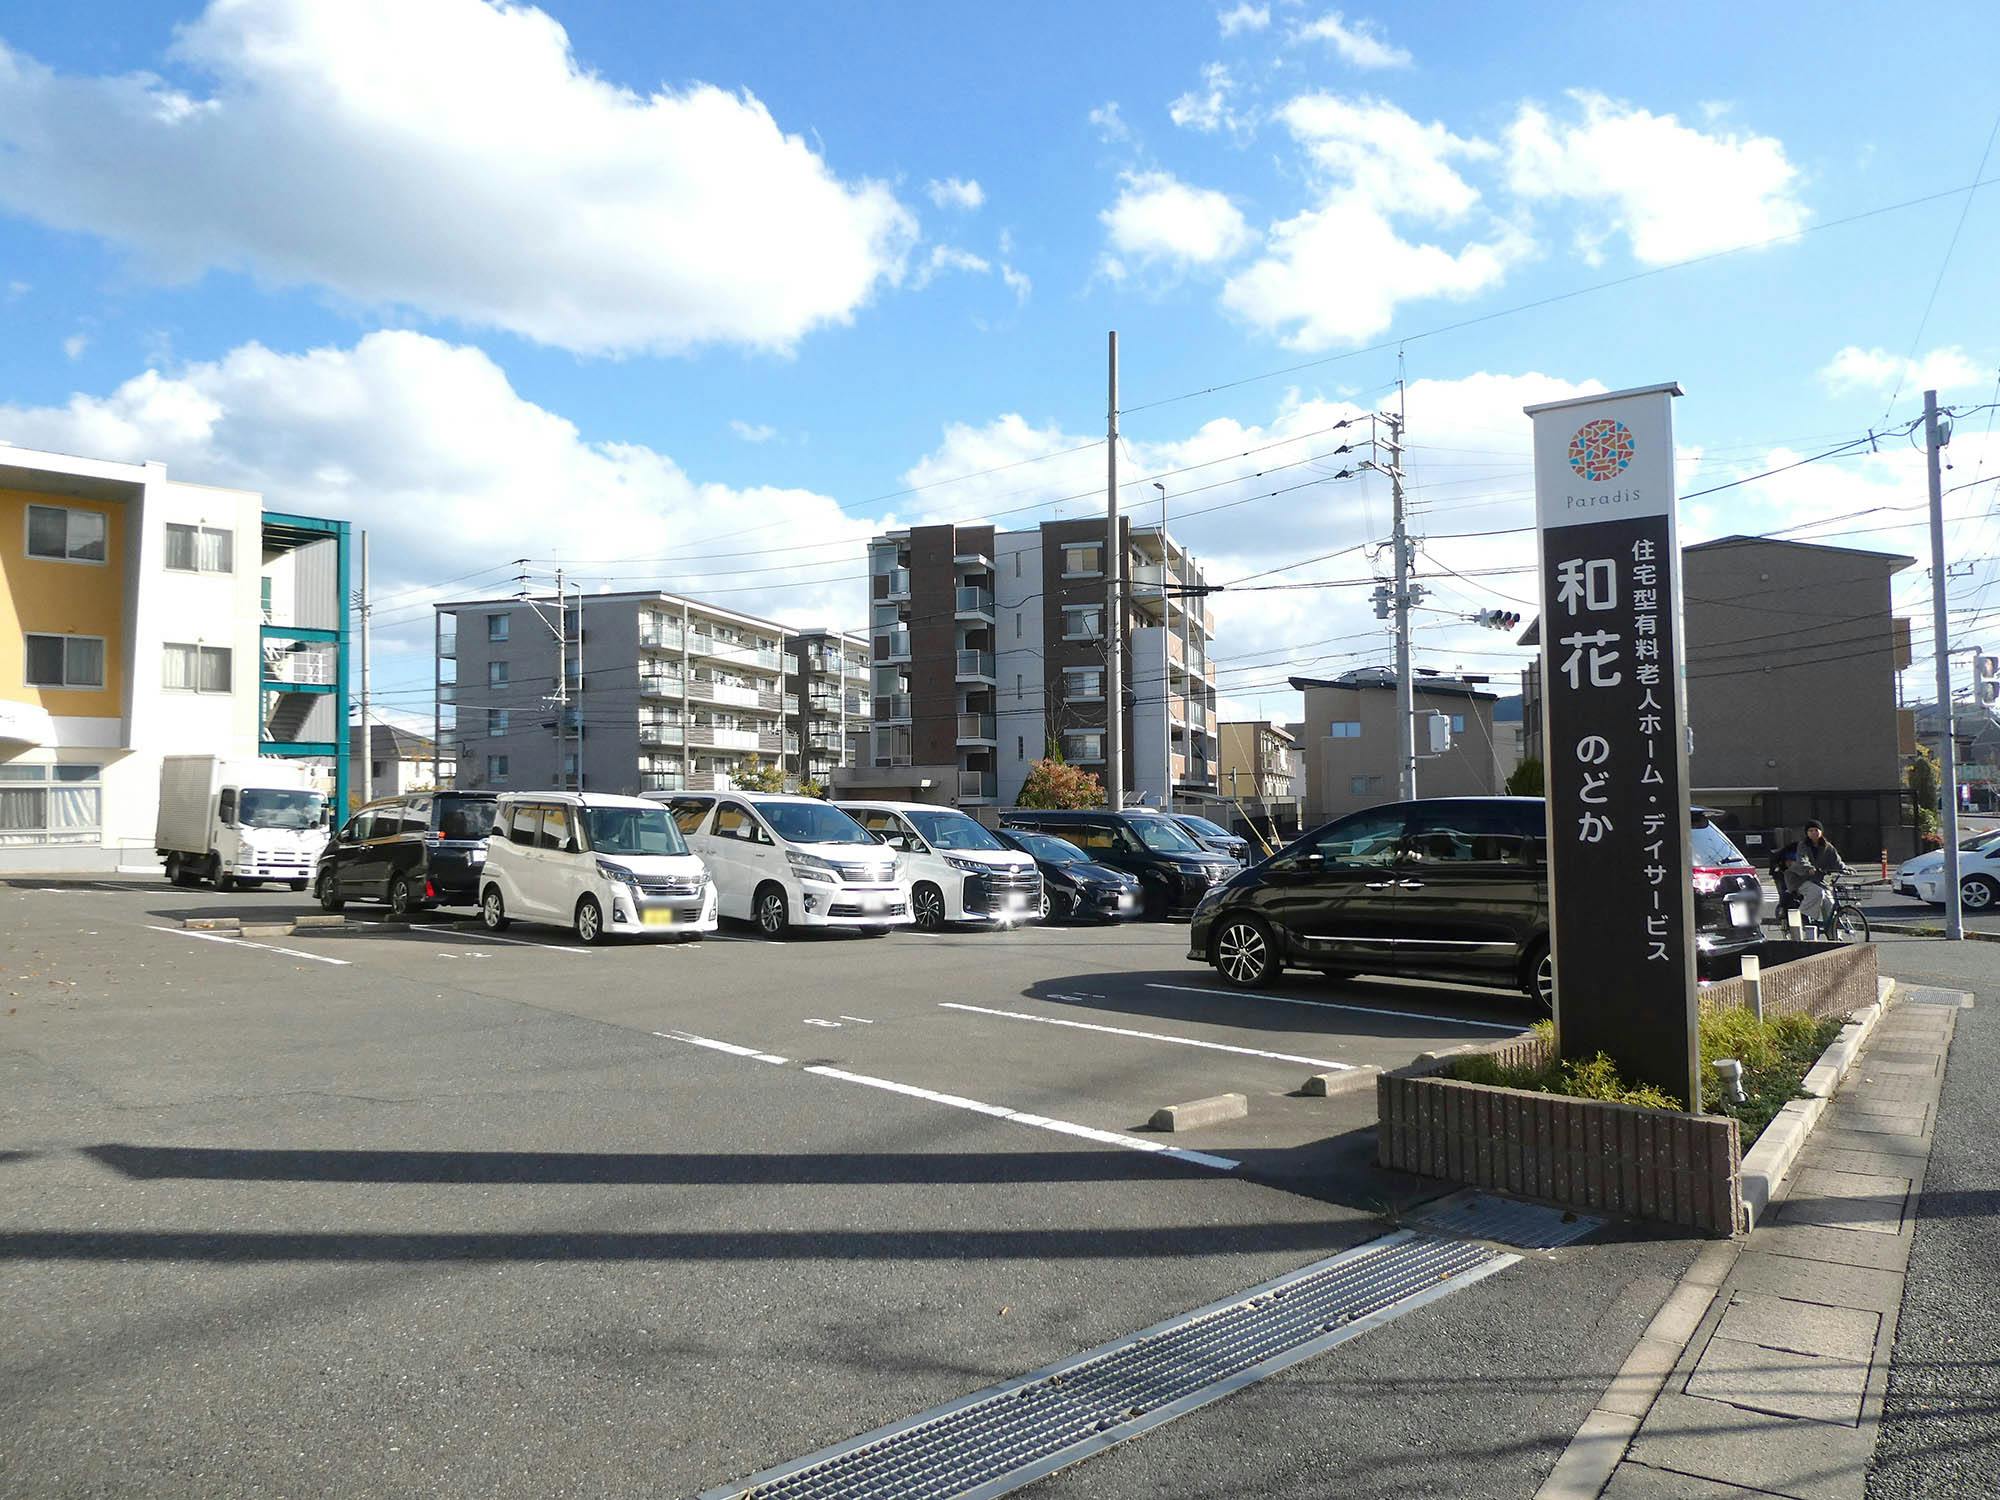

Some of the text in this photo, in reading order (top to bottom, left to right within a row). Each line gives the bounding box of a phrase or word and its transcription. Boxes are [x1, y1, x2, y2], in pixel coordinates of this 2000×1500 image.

[1567, 489, 1640, 508] Paradis
[1556, 557, 1622, 843] 和花 のどか
[1632, 538, 1671, 962] 住宅型有料老人ホーム・デイサービス
